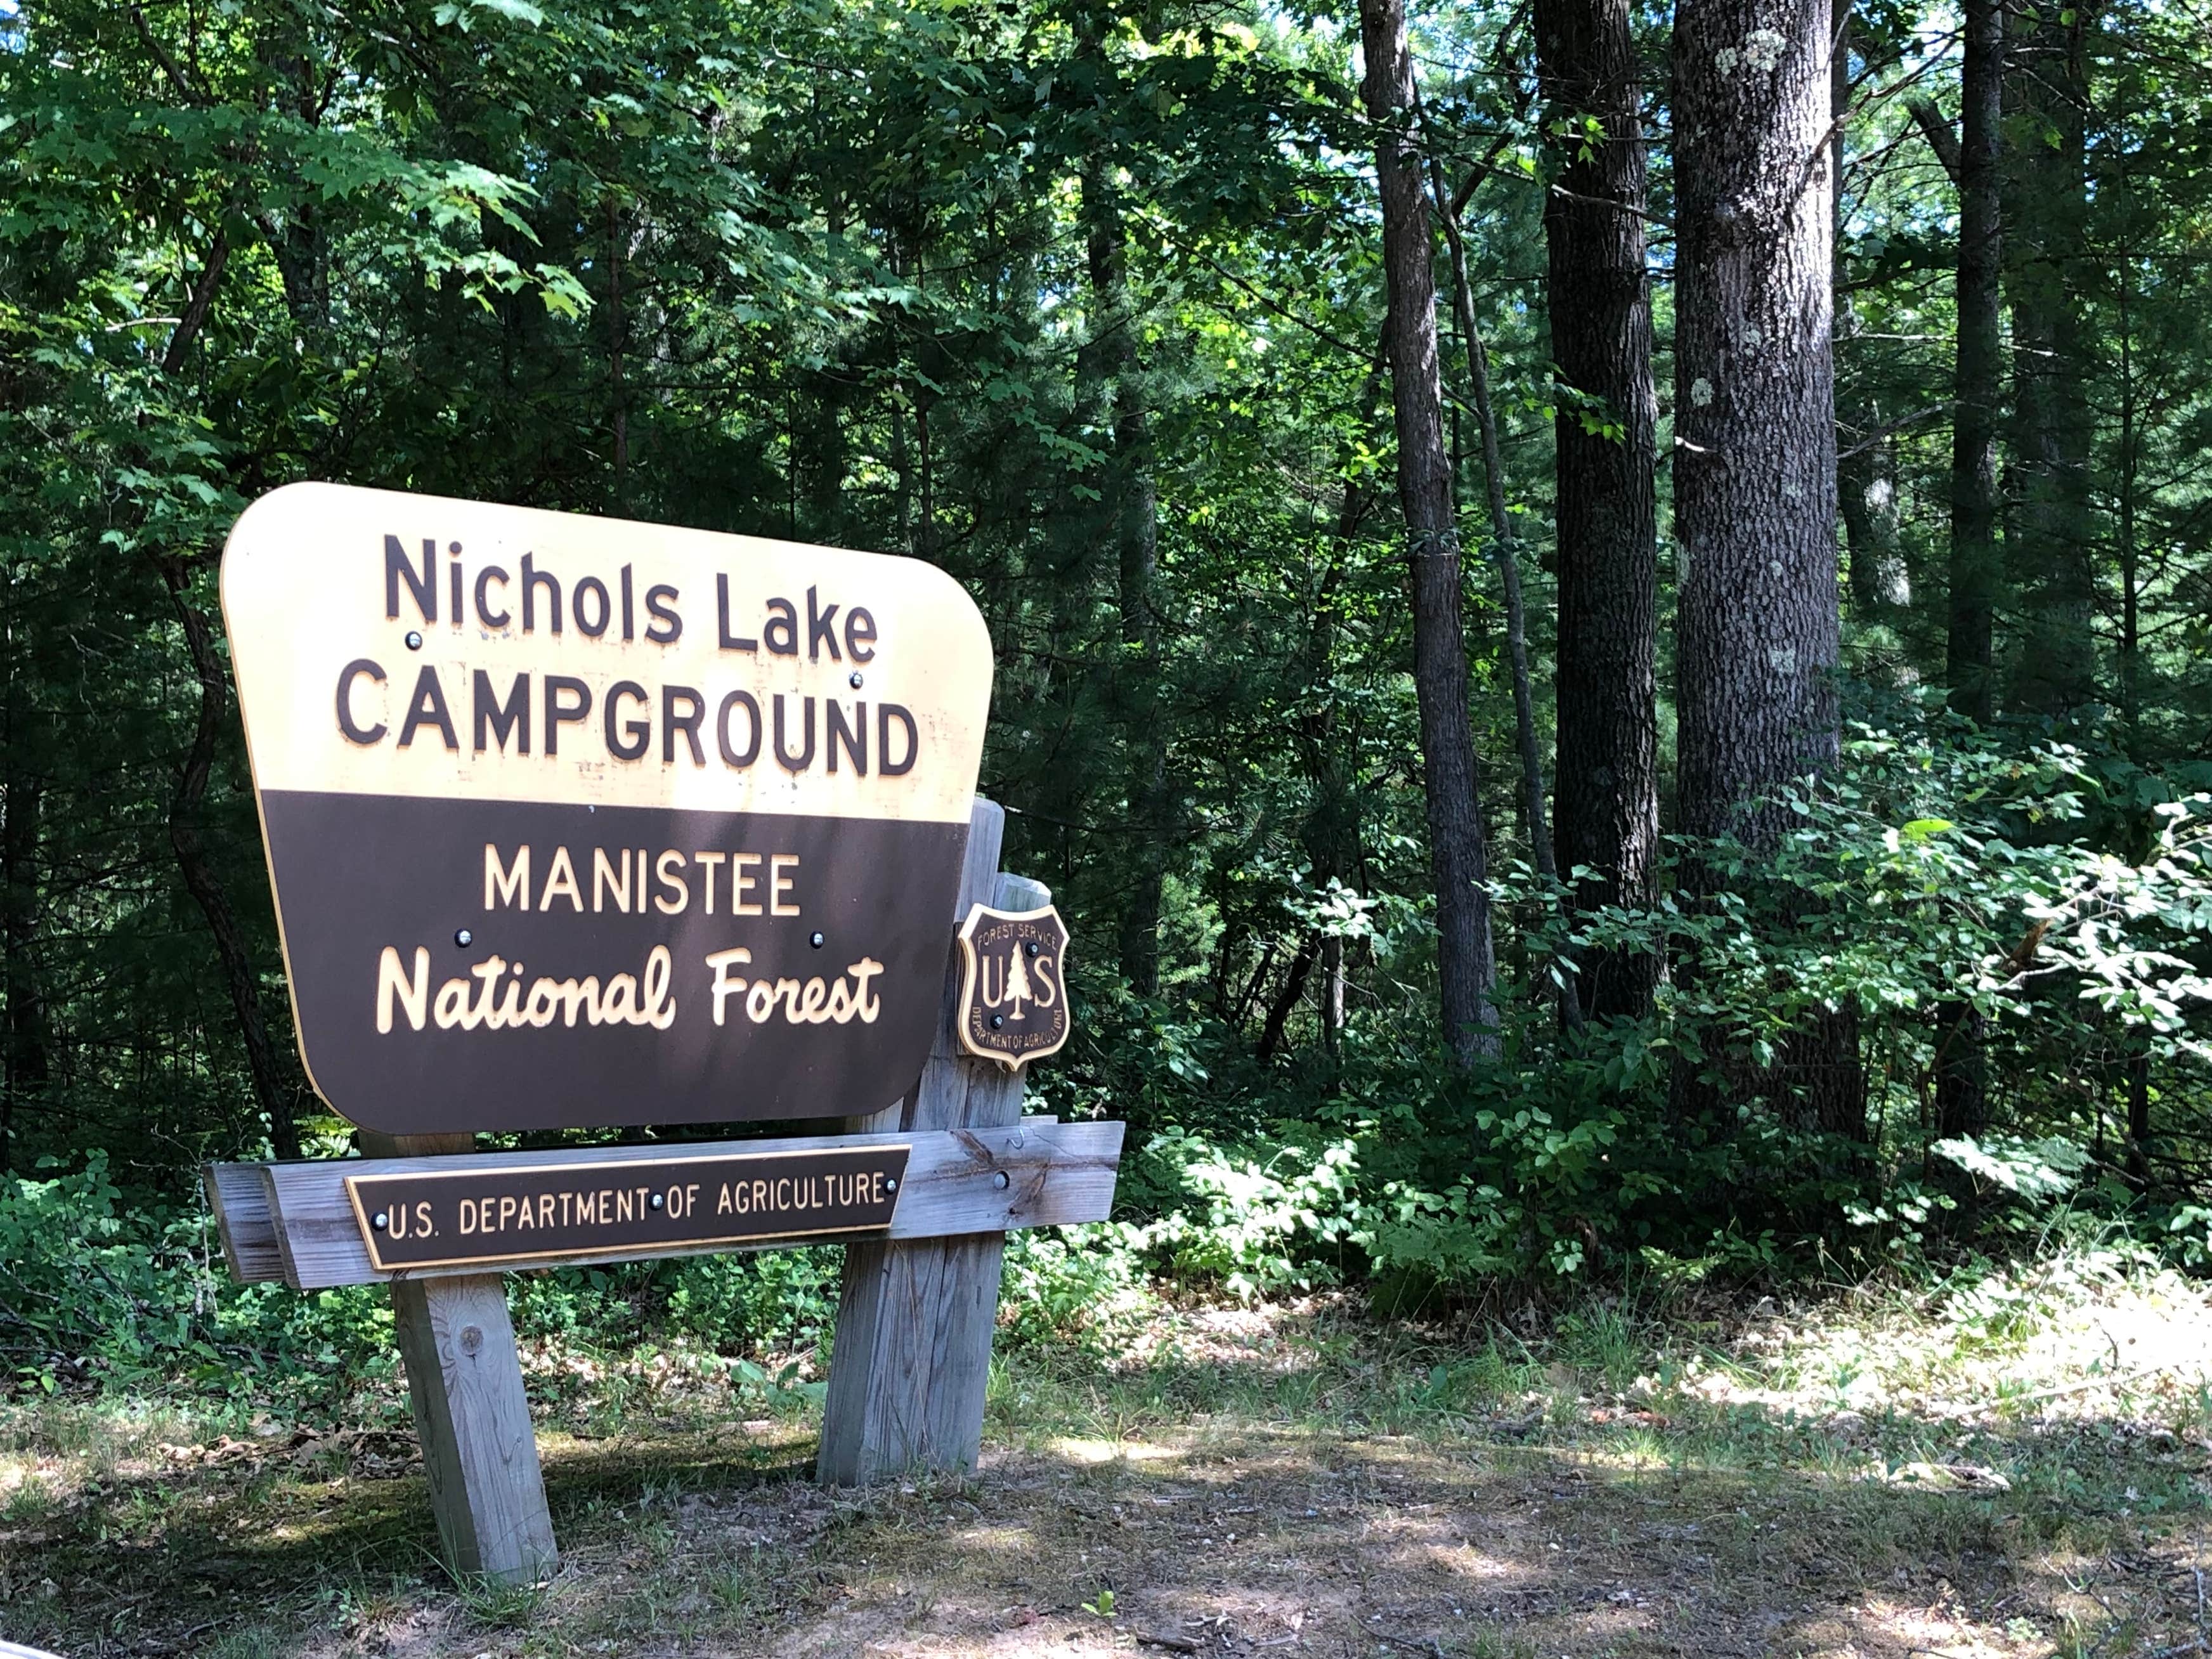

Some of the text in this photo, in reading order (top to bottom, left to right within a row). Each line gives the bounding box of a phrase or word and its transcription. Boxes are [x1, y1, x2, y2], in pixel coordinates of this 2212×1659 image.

[383, 534, 878, 663] Nichols Lake
[336, 658, 918, 777] CAMPGROUND
[485, 843, 800, 916] MANISTEE
[977, 924, 1057, 951] FOREST SERVICE
[377, 945, 884, 1034] National Forest
[982, 955, 1056, 1008] U S
[972, 1006, 1012, 1047] DEPARTMENT
[1013, 1037, 1024, 1049] OF
[389, 1171, 885, 1239] U.S. DEPARTMENT OF AGRICULTURE
